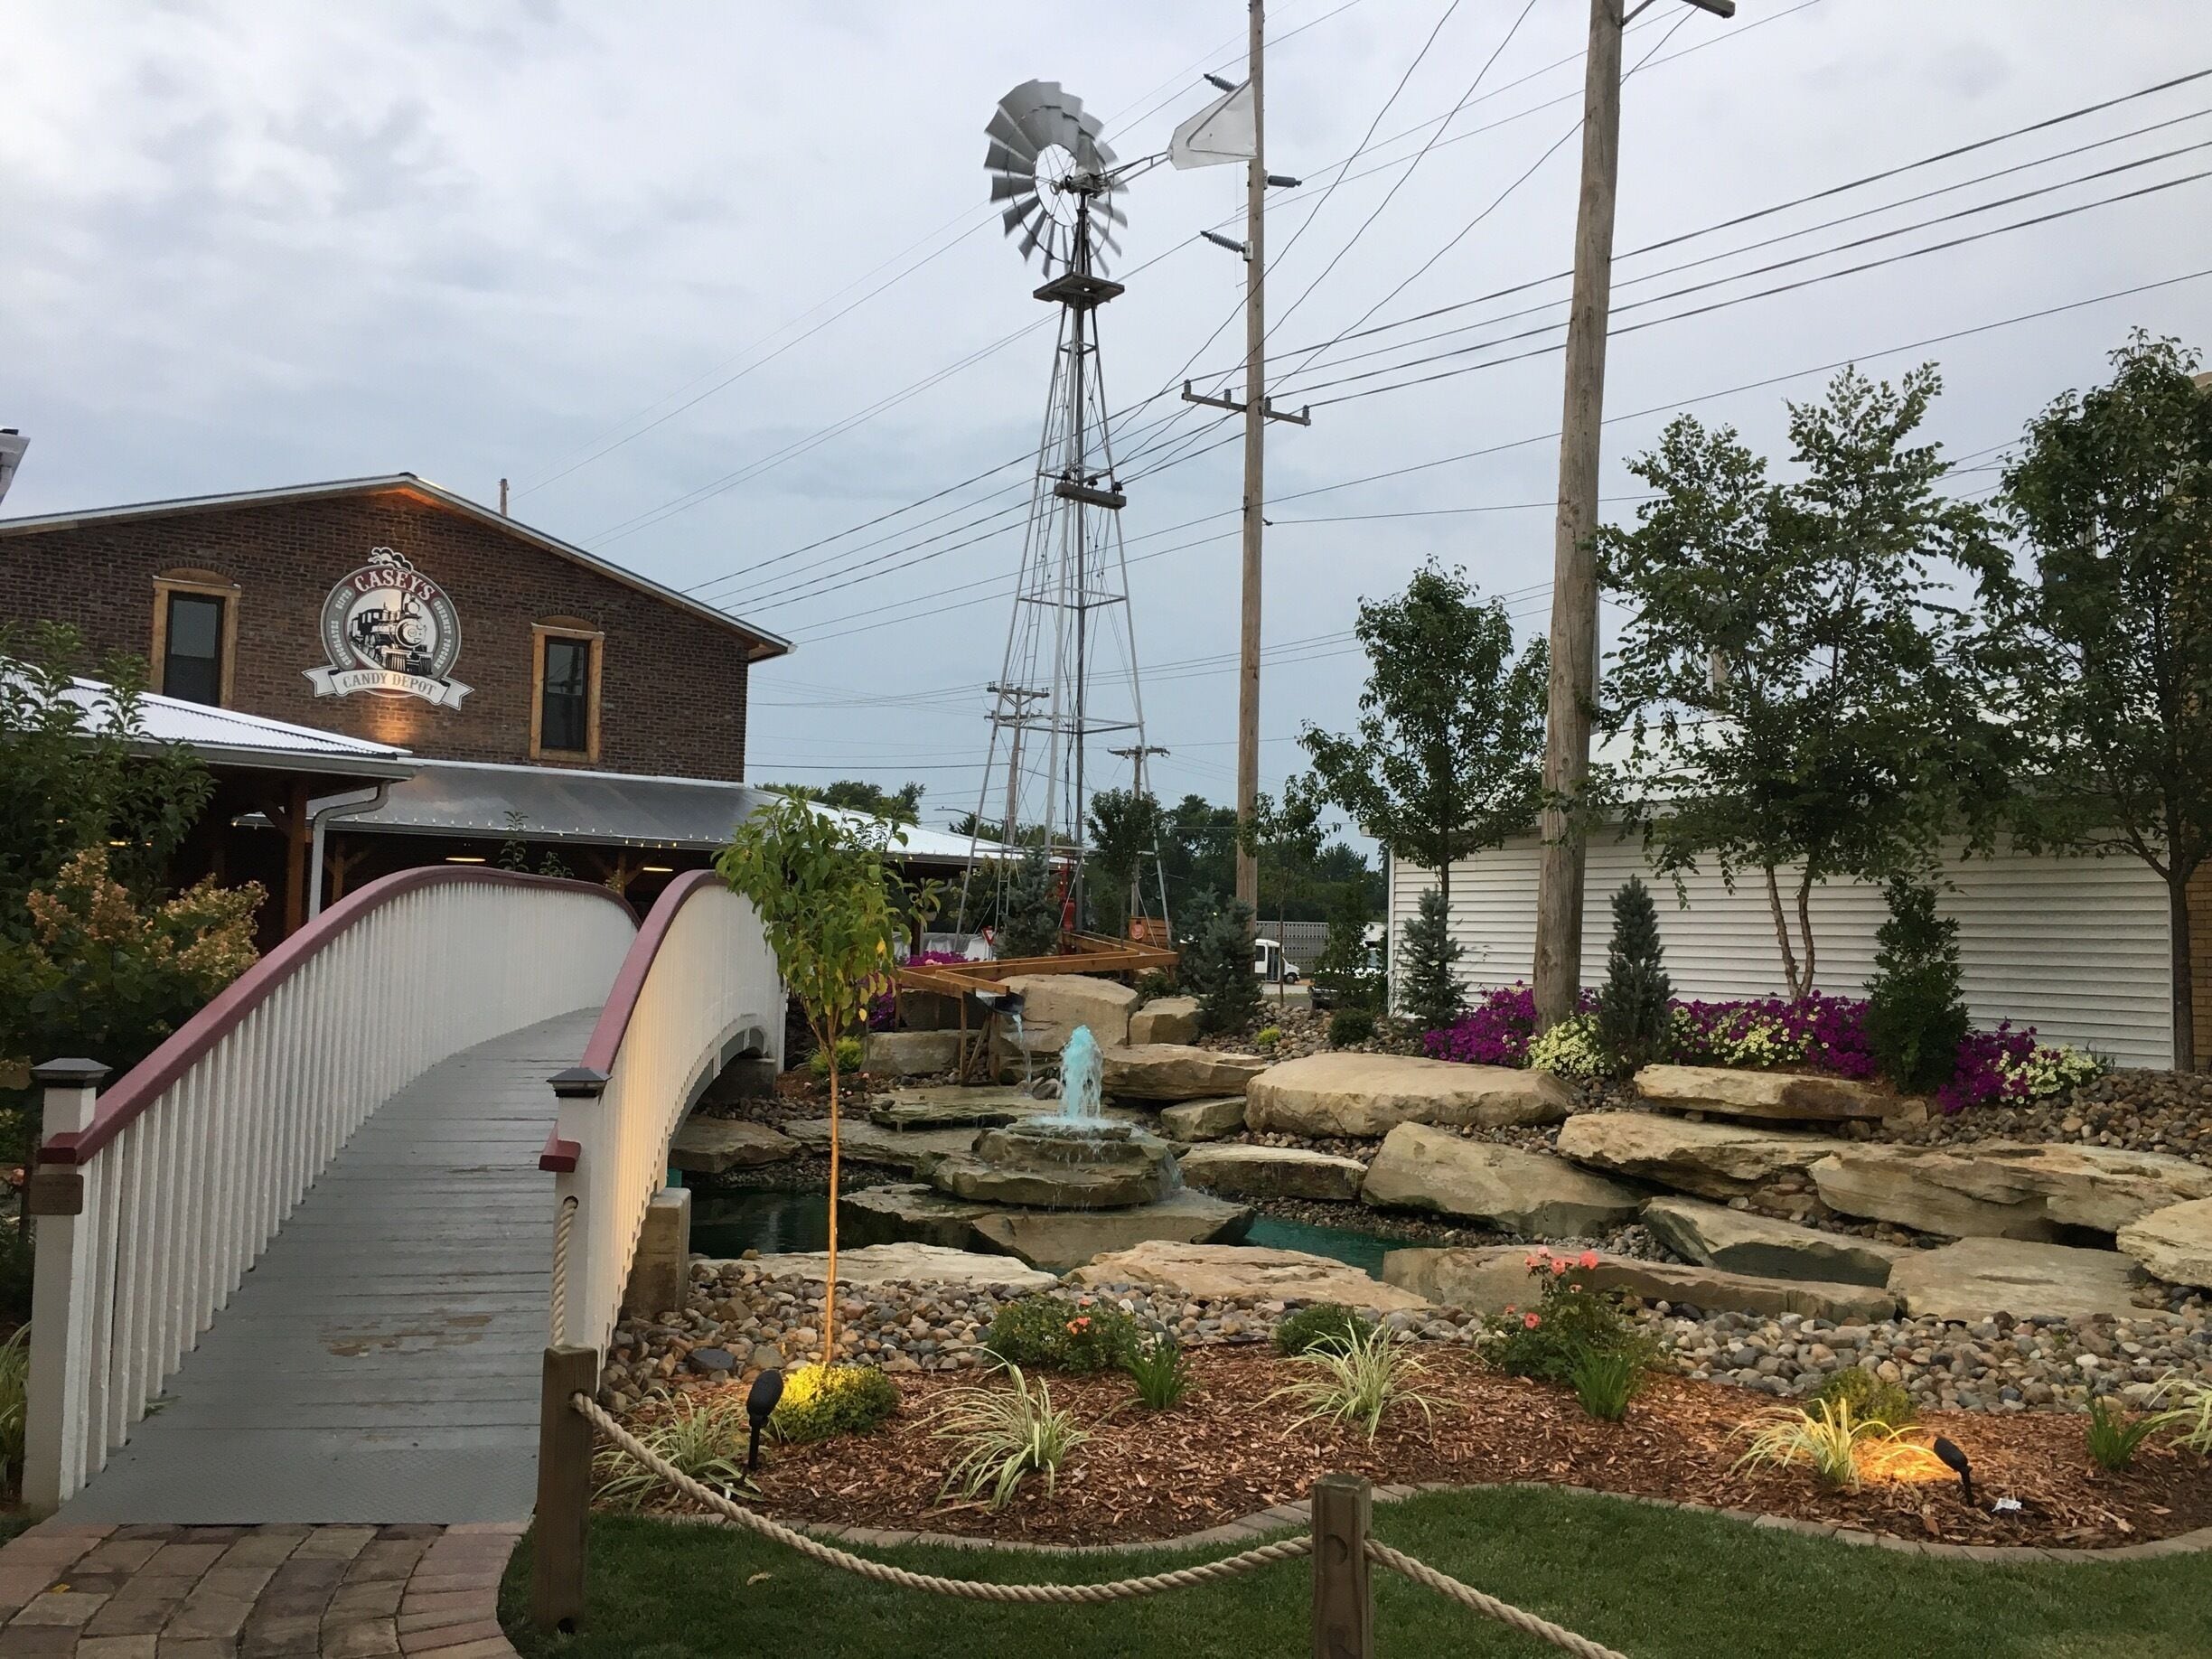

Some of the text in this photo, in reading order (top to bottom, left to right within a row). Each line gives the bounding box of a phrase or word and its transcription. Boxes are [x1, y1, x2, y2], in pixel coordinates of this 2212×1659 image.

[354, 568, 435, 601] CASEY'S
[342, 672, 437, 696] CANDY DEPOT
